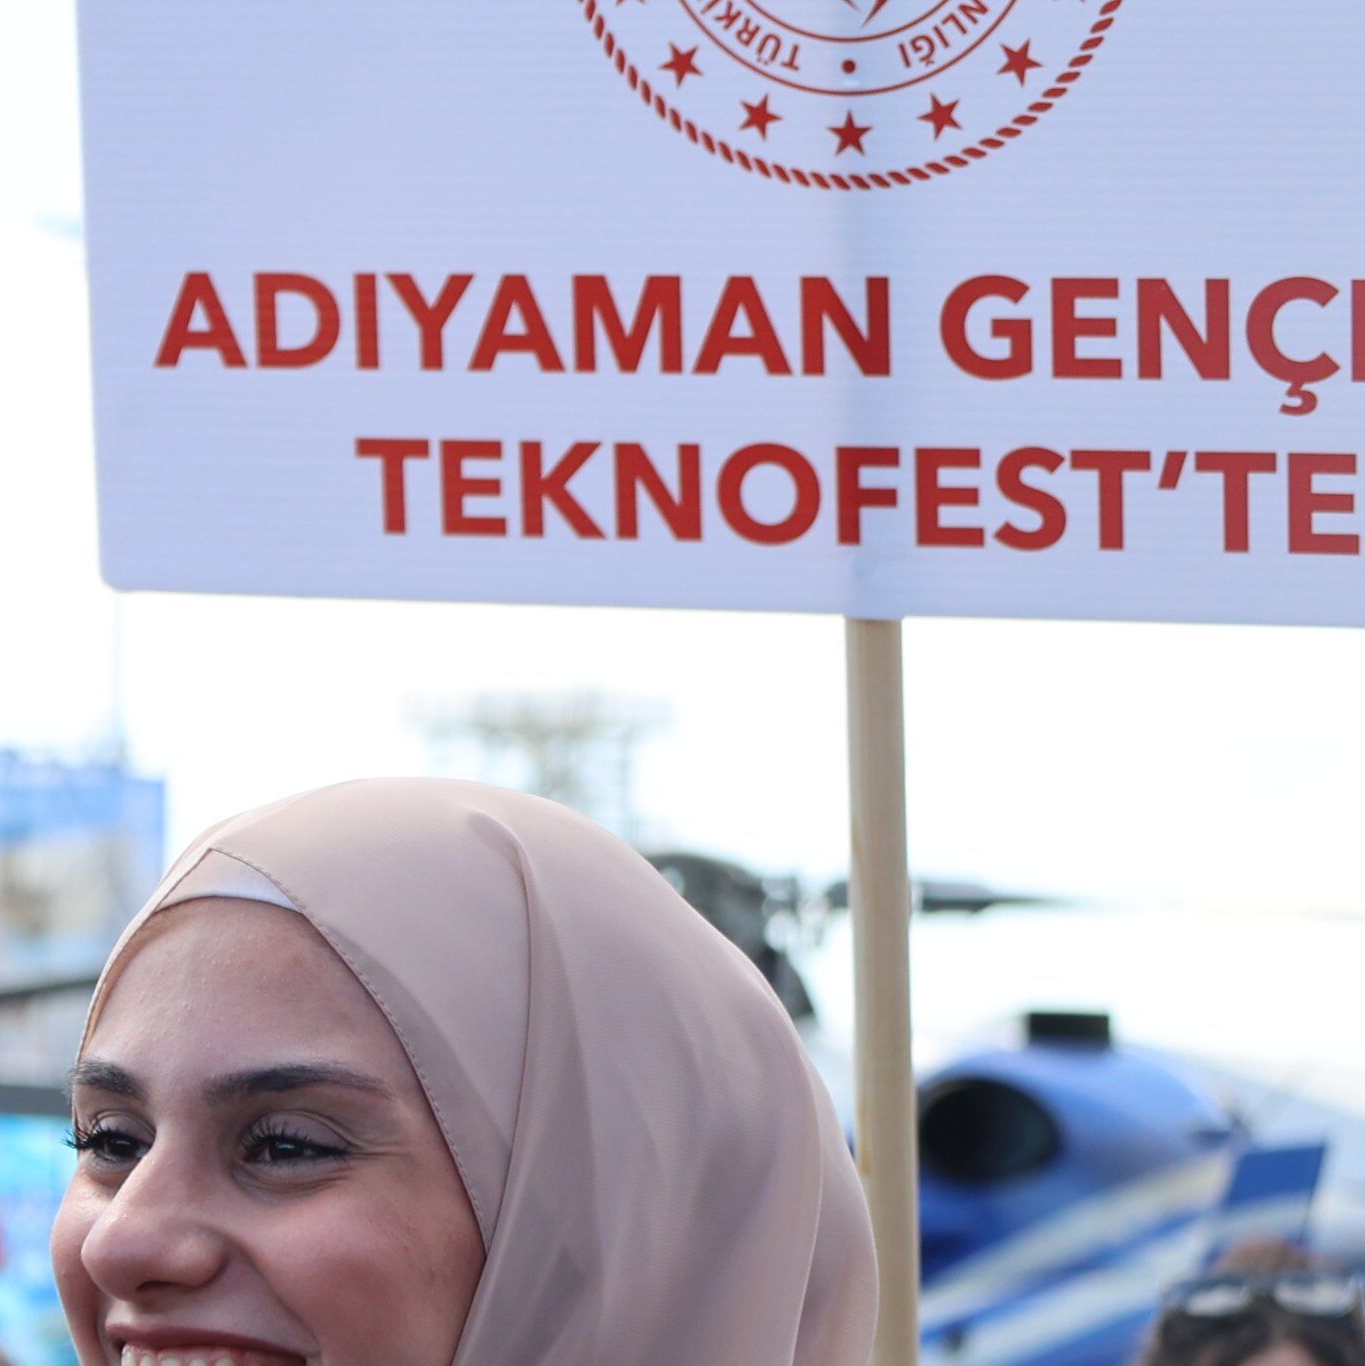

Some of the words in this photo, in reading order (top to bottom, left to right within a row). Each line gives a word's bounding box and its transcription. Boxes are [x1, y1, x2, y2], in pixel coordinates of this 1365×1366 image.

[156, 272, 891, 377] ADIYAMAN
[940, 275, 1365, 416] GENÇ
[356, 437, 1361, 554] TEKNOFEST'TE
